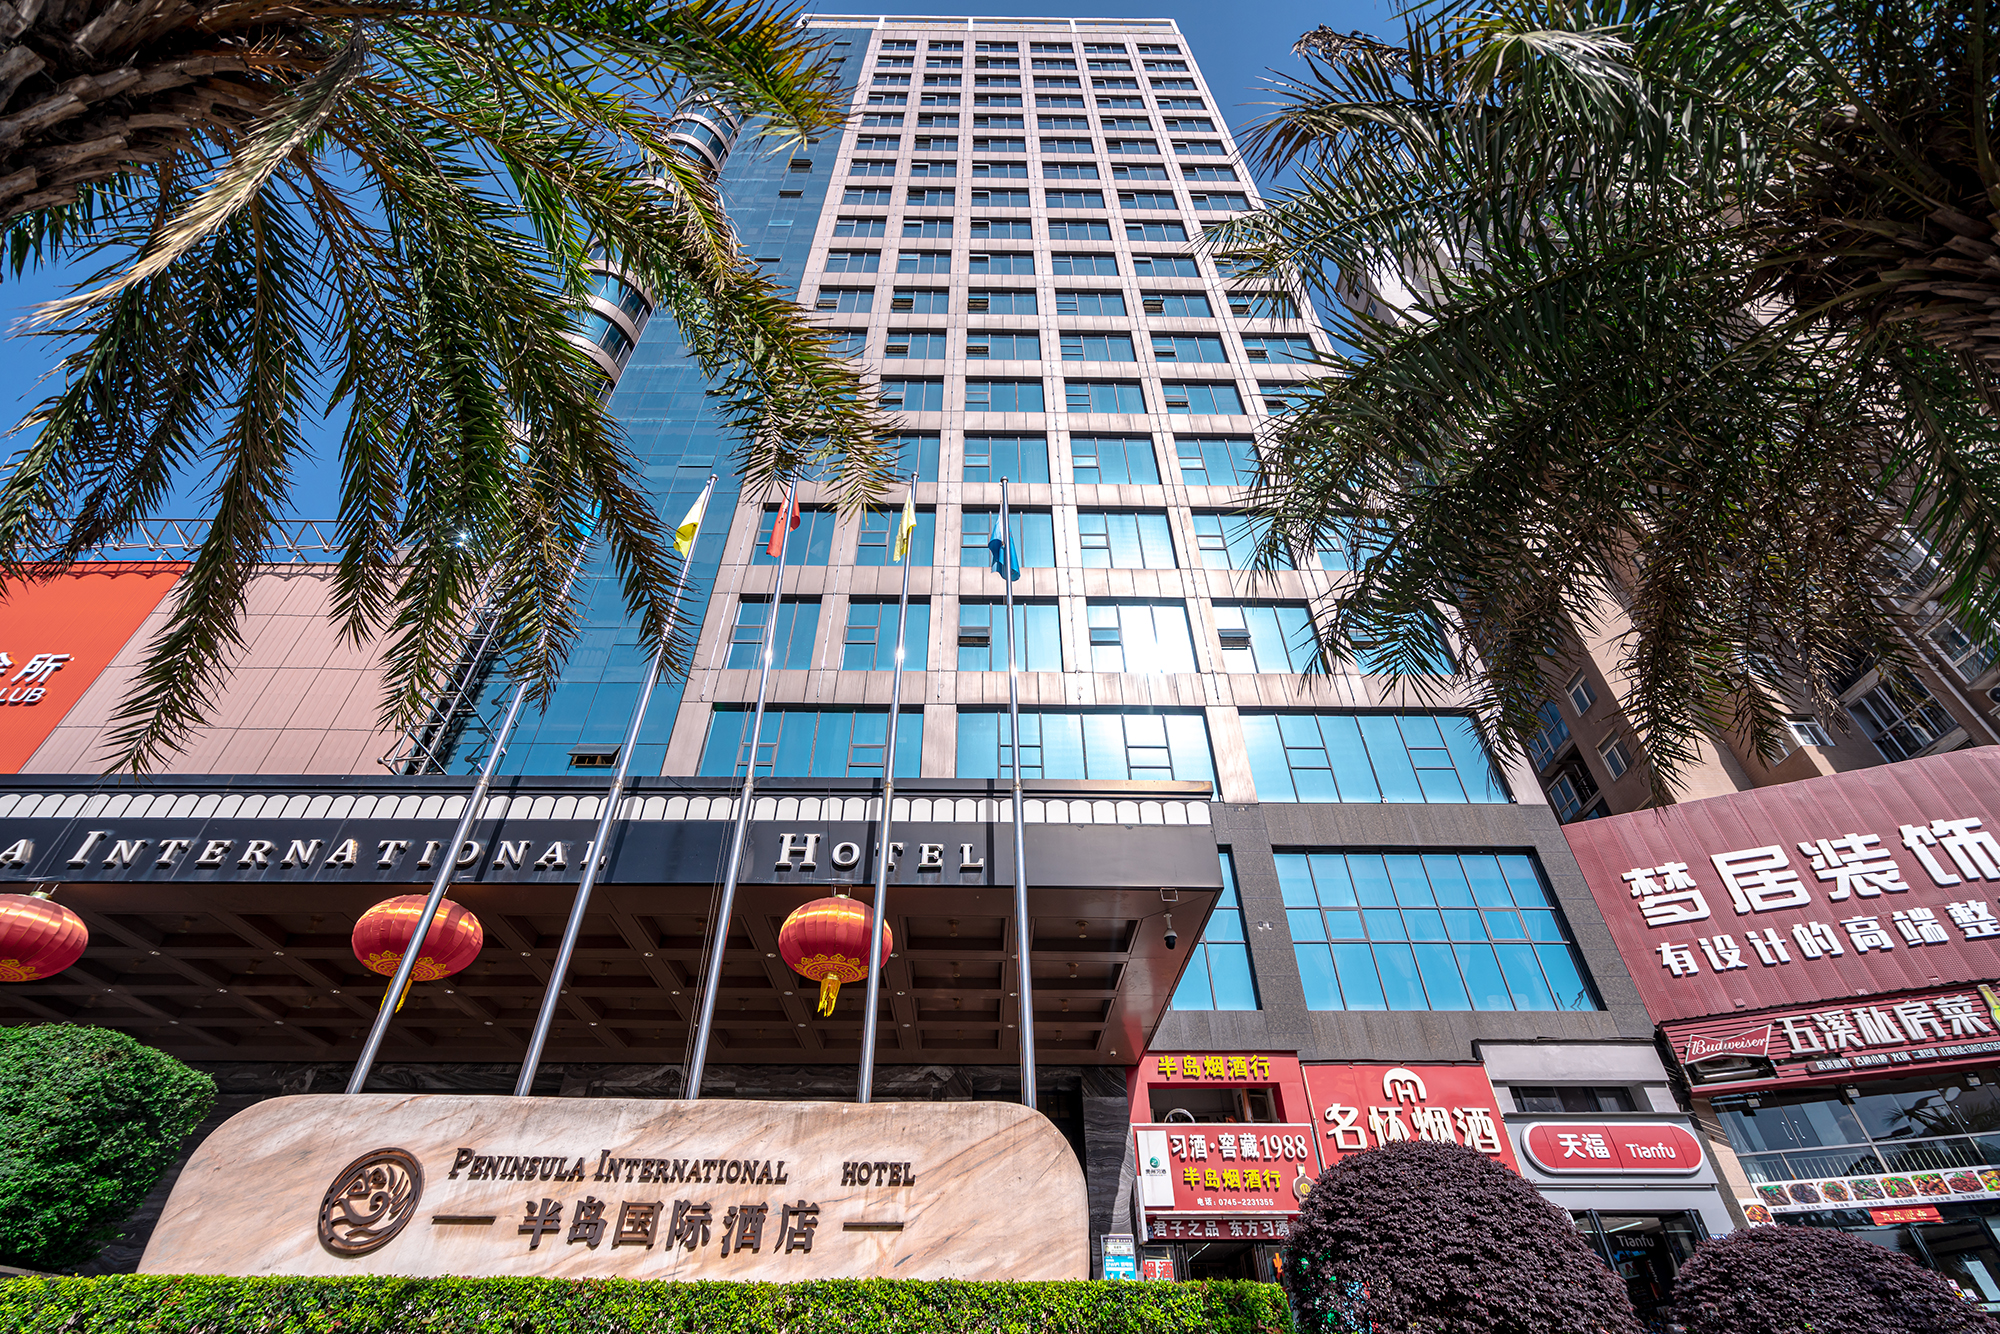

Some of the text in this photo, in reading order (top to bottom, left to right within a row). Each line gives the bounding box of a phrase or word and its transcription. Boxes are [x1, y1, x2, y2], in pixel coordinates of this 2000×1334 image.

[67, 830, 608, 869] INTERNATIONAL
[774, 833, 985, 870] HOTEL
[1622, 817, 2000, 927] 梦居装饰
[1656, 900, 2000, 977] 有设计的高端整
[1775, 995, 1992, 1055] 五溪私房菜
[1684, 1036, 1769, 1056] Budweiser
[1158, 1054, 1271, 1079] 半岛烟酒行
[1324, 1103, 1502, 1153] 名怀烟酒
[1557, 1133, 1677, 1160] 天福 Tianfu
[447, 1147, 917, 1187] PENINSULA INTERNATIONAL HOTEL
[1183, 1166, 1282, 1189] 半岛烟酒行
[517, 1196, 821, 1257] 半岛国际酒店
[1153, 1220, 1290, 1237] 君子之品 东方习酒
[1616, 1233, 1655, 1247] Tianfu
